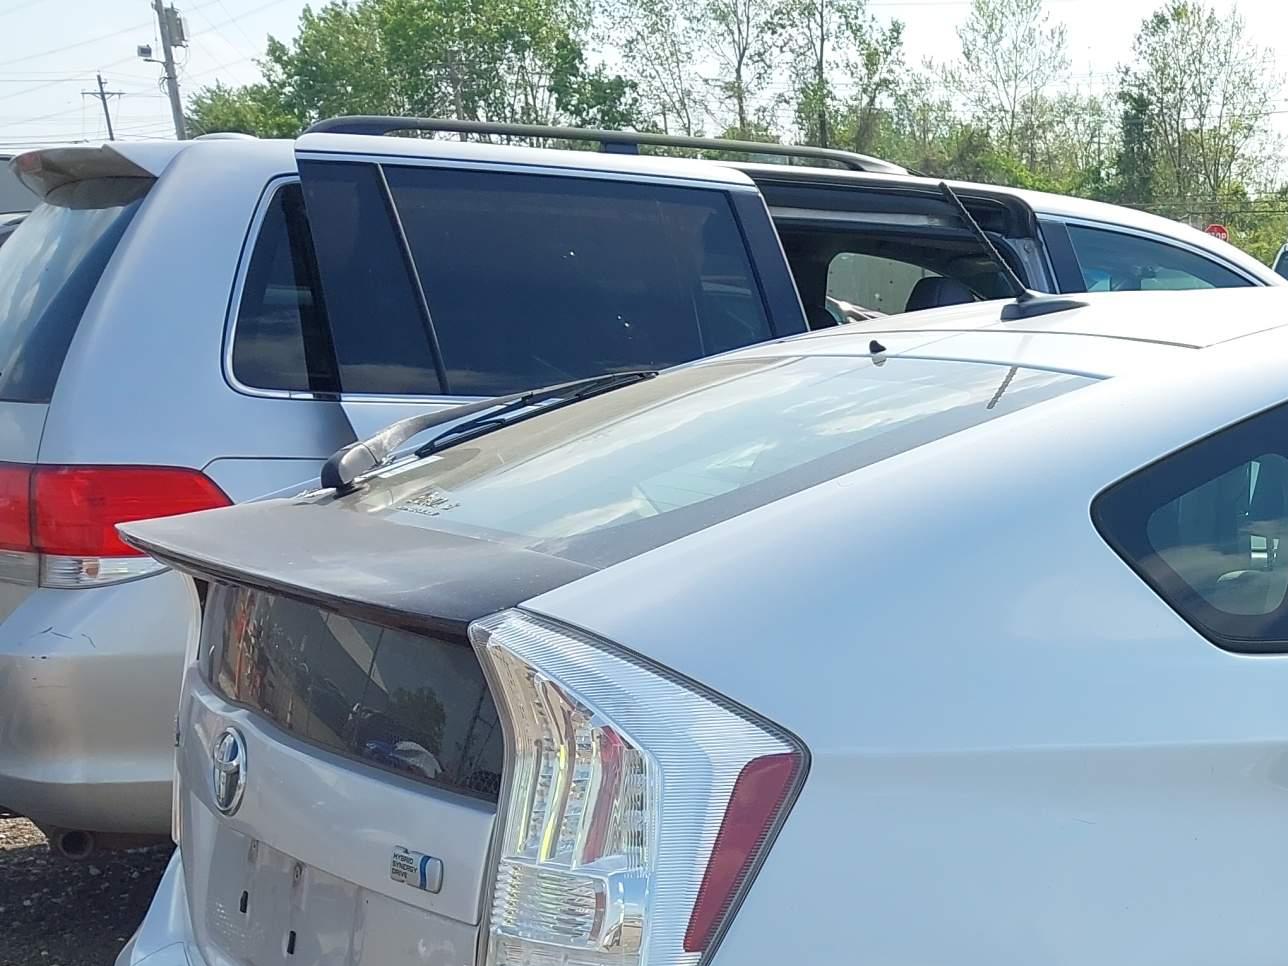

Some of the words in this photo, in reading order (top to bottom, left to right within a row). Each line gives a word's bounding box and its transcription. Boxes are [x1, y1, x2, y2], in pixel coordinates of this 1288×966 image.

[392, 853, 414, 865] HYBRID
[392, 860, 418, 873] SYNERGY
[391, 867, 407, 879] DRIVE
